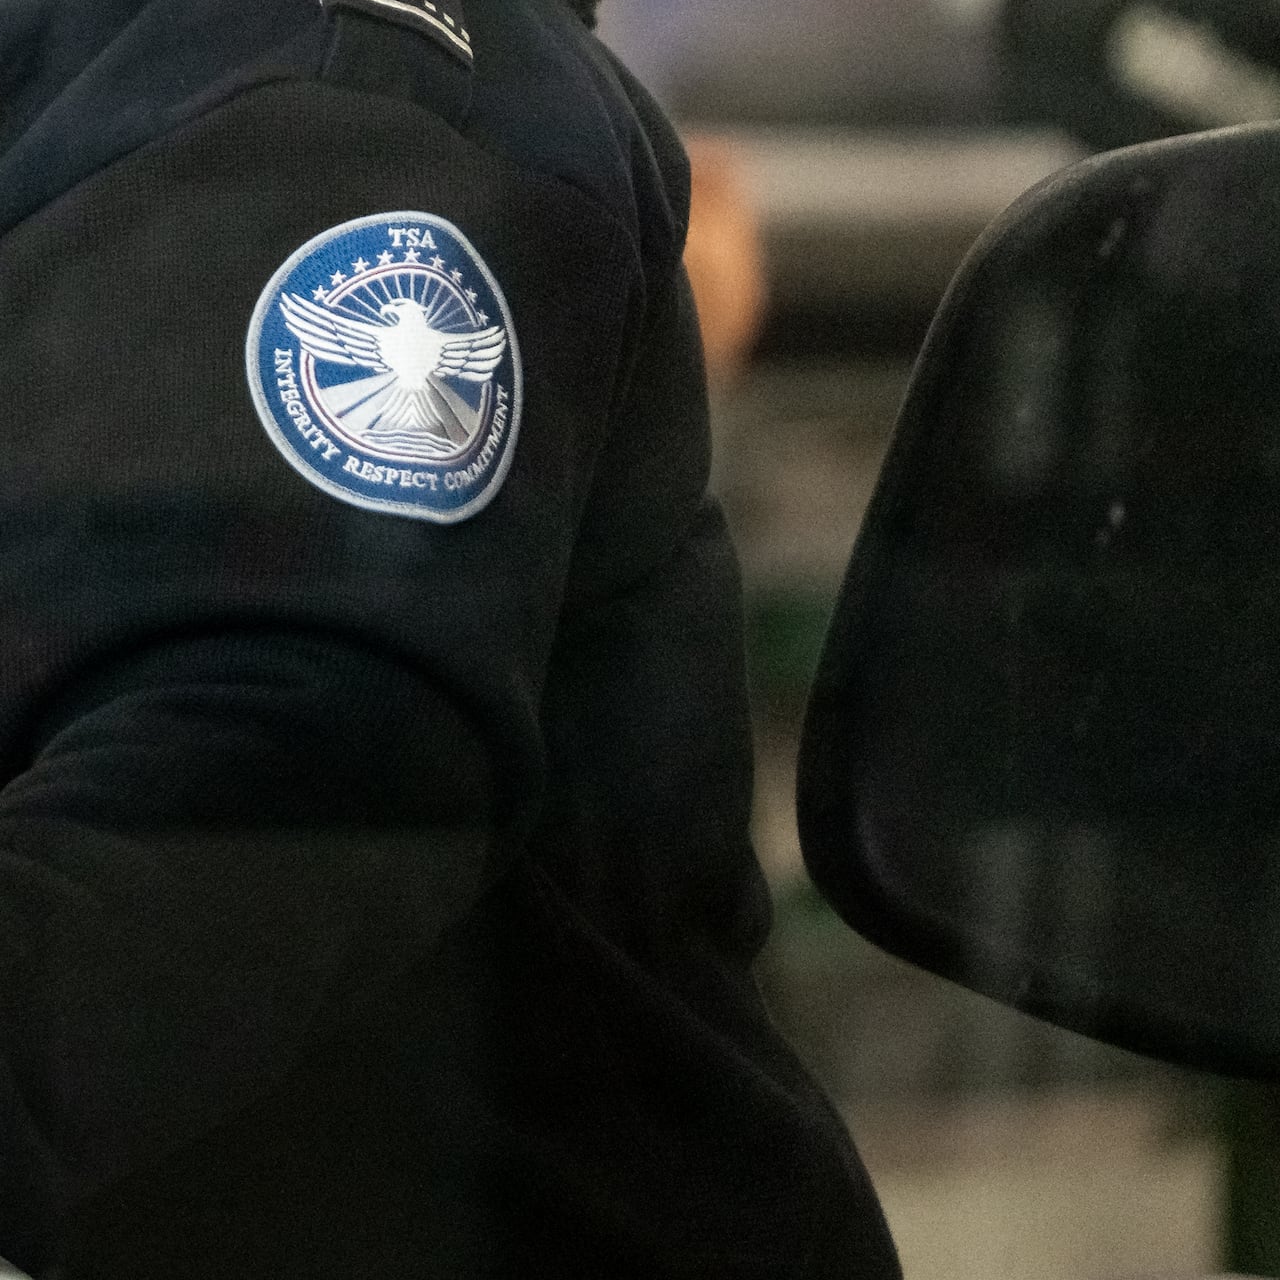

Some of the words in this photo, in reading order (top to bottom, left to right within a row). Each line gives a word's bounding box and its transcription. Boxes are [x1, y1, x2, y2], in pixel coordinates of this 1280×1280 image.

[387, 227, 438, 250] TSA
[273, 347, 341, 461] INTEGRITY
[342, 456, 439, 491] RESPECT
[443, 383, 510, 490] COMMITMENT
